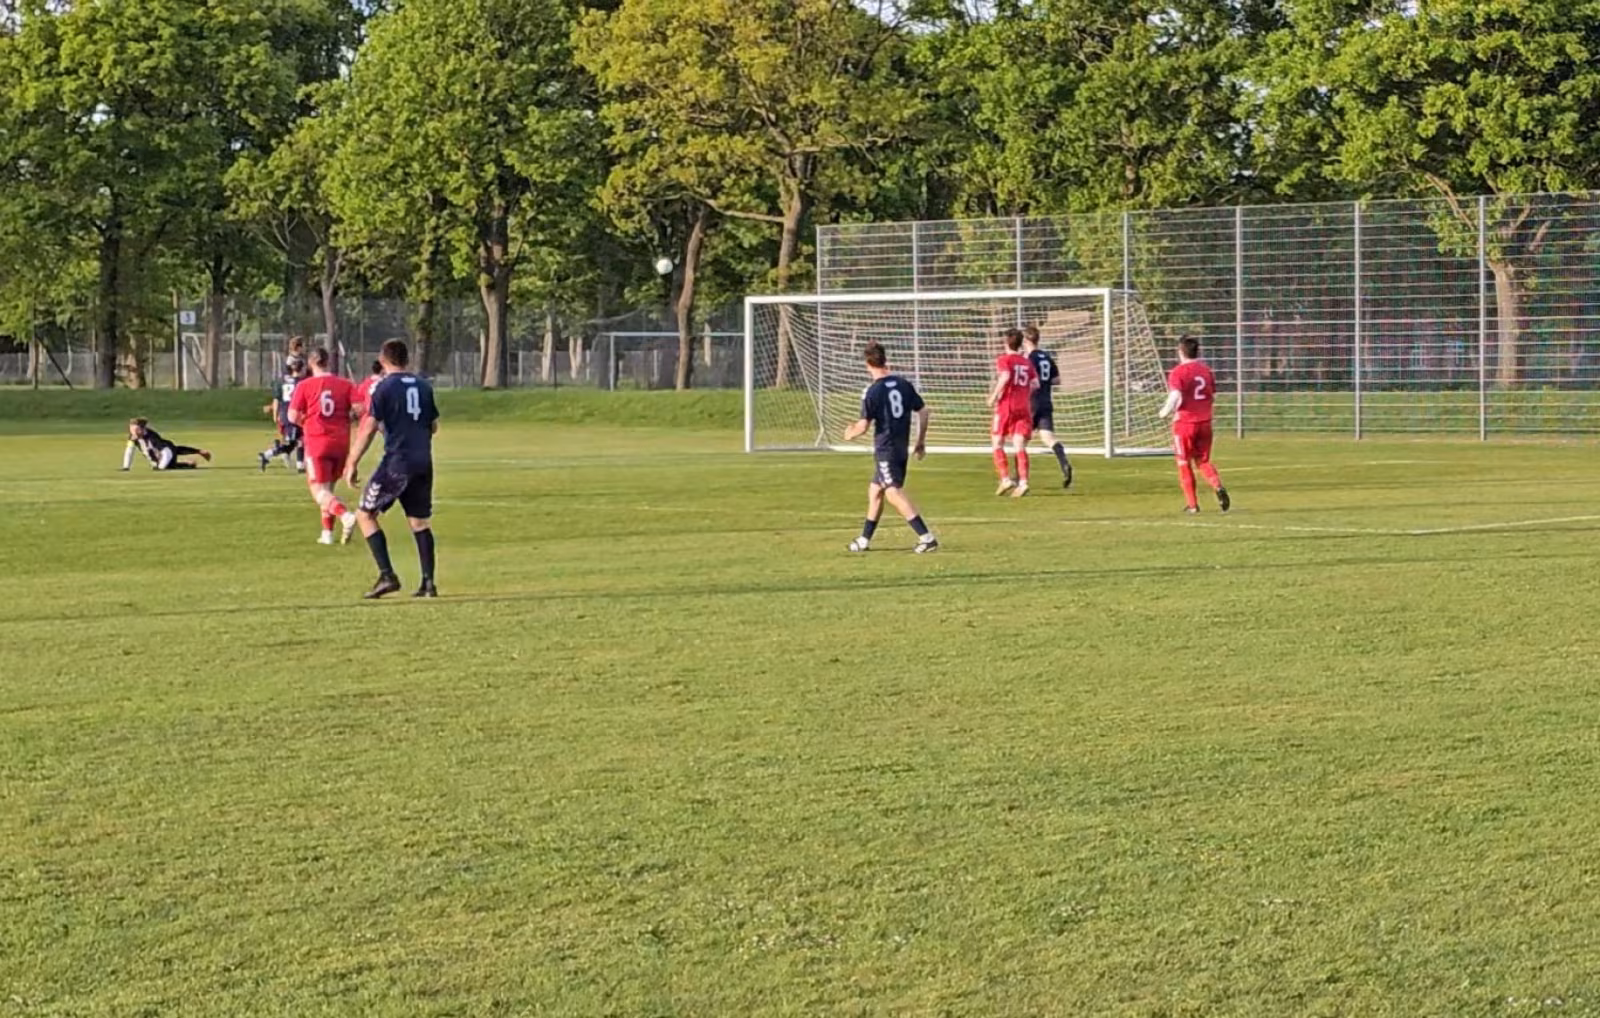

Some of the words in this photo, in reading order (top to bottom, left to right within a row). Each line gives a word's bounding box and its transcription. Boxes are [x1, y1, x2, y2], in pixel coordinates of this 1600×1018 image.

[1014, 364, 1030, 387] 15
[1194, 375, 1206, 400] 2
[320, 390, 335, 417] 6
[406, 387, 421, 421] 4
[888, 389, 904, 419] 8
